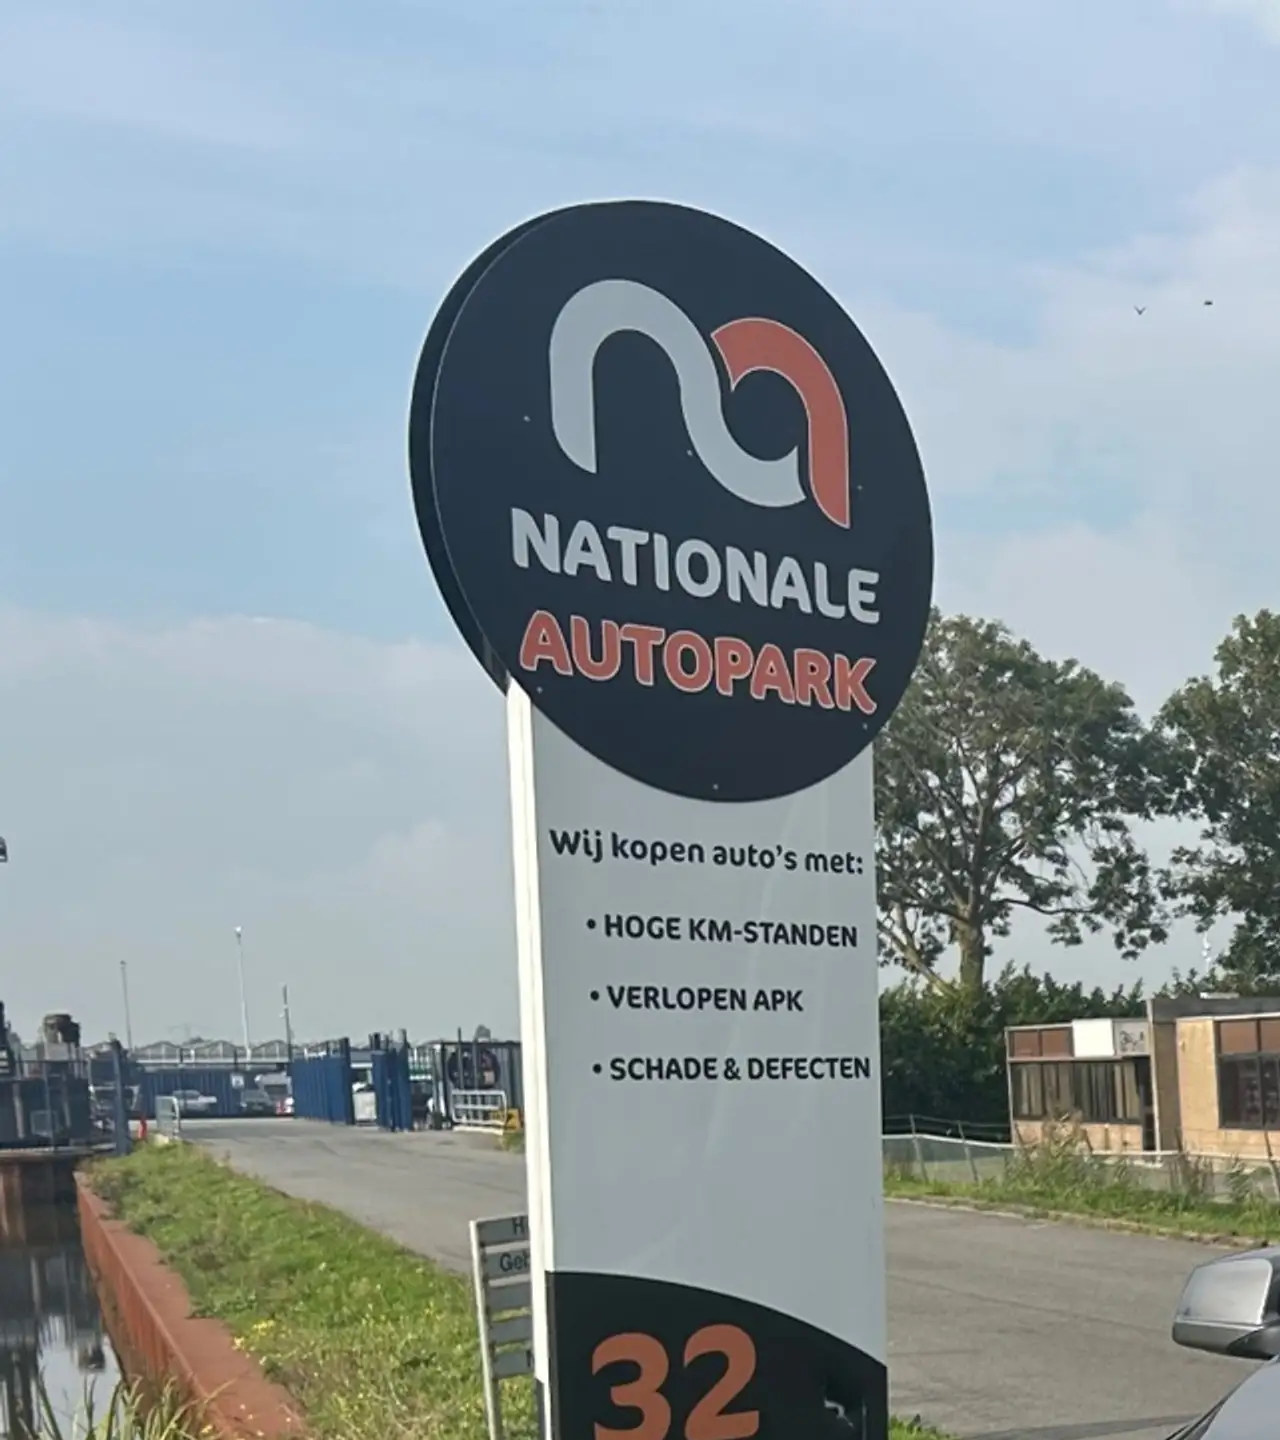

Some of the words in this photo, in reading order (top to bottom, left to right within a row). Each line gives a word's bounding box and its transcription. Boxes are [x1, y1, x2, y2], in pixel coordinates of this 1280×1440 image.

[511, 506, 881, 624] NATIONALE
[519, 610, 877, 715] AUTOPARK
[549, 829, 603, 863] Wij
[611, 832, 705, 866] kopen
[712, 844, 798, 871] auto's
[805, 851, 864, 875] met:
[604, 914, 681, 940] HOGE
[689, 918, 858, 948] KM-STANDEN
[607, 985, 747, 1011] VERLOPEN
[753, 989, 803, 1012] APK
[610, 1057, 718, 1081] SCHADE
[723, 1057, 741, 1081] &
[747, 1057, 871, 1080] DEFECTEN
